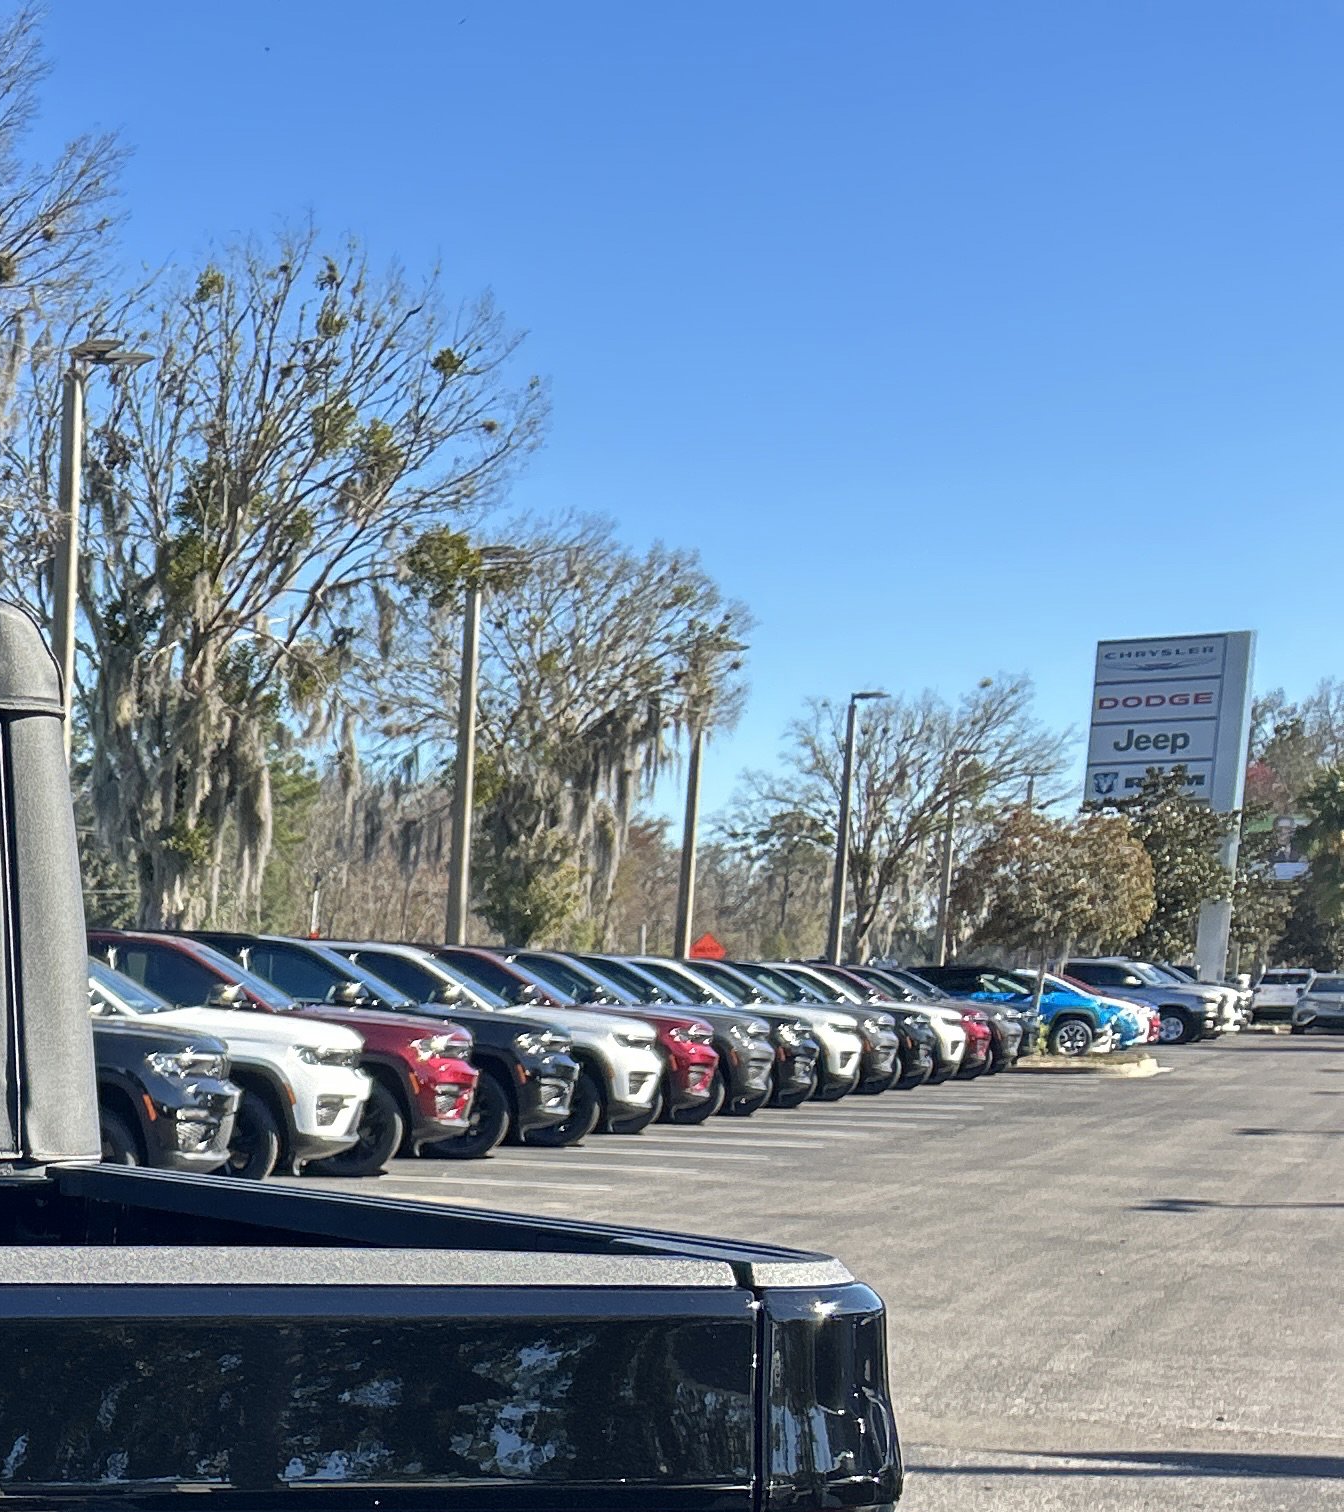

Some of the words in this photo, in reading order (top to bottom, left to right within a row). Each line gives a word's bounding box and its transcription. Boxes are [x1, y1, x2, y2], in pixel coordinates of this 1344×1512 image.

[1104, 646, 1214, 660] CHRYSLER
[1098, 692, 1213, 709] DODGE
[1114, 729, 1190, 754] Jeep
[1124, 774, 1205, 788] RM
